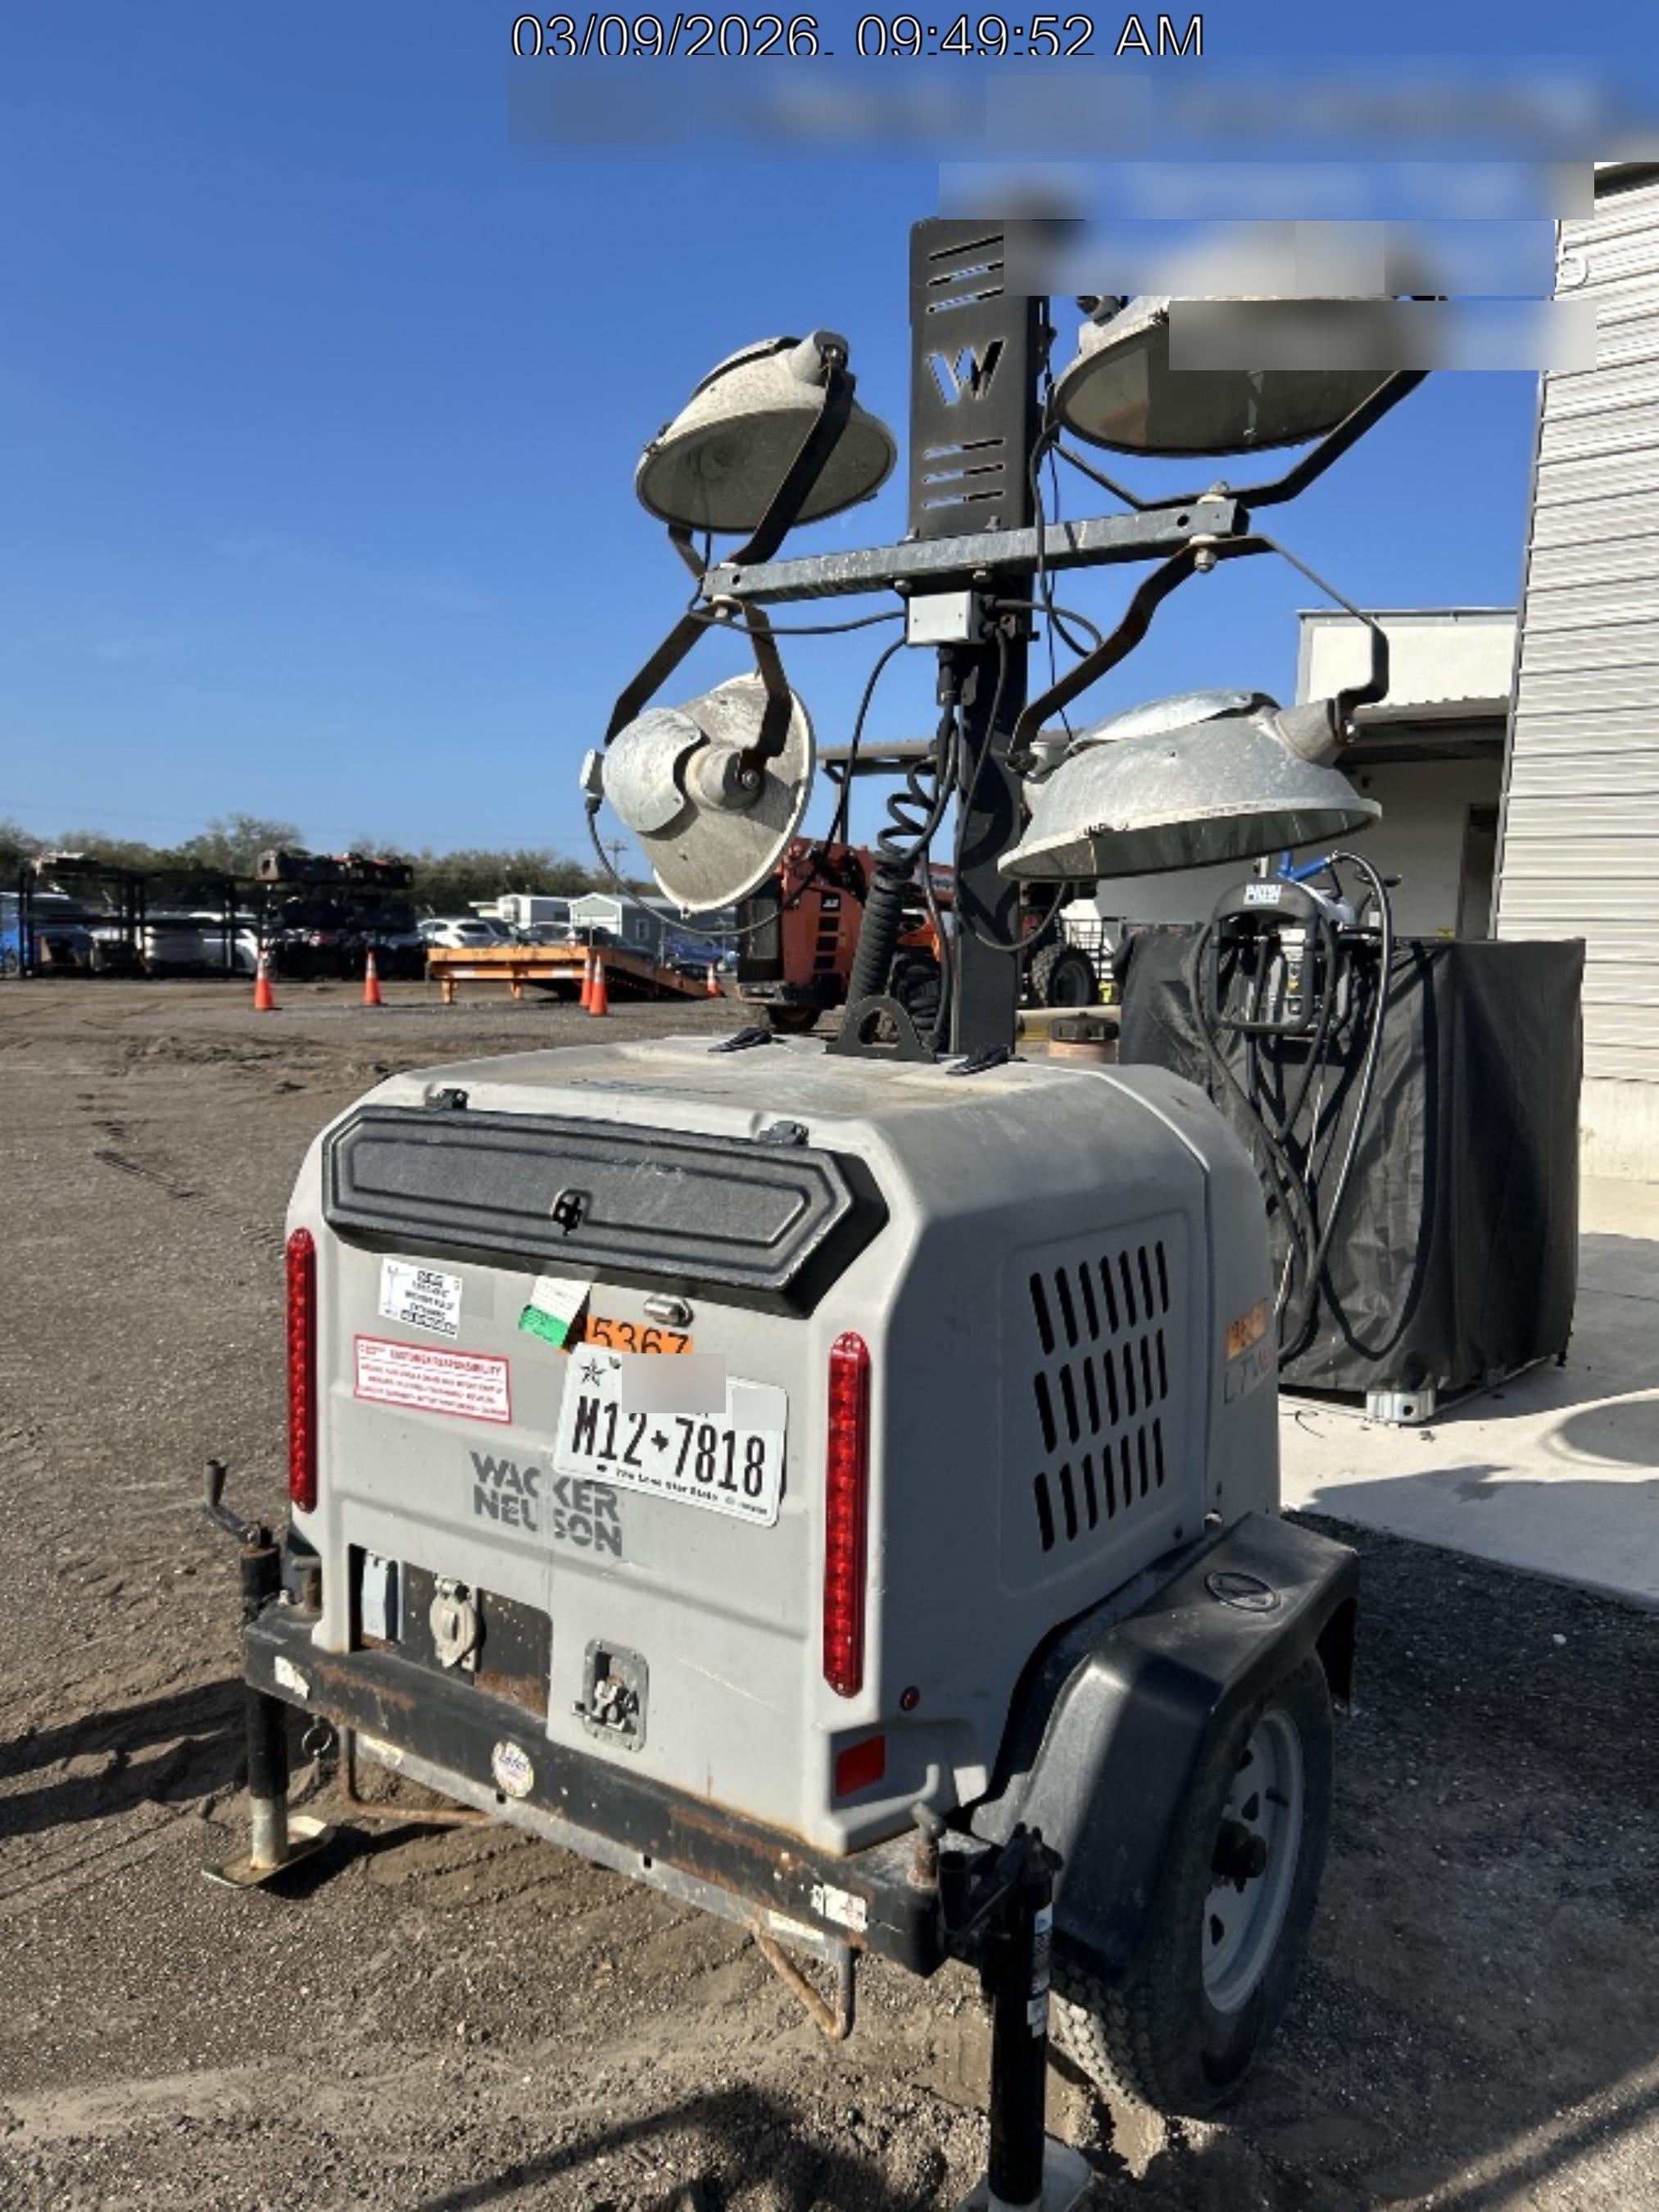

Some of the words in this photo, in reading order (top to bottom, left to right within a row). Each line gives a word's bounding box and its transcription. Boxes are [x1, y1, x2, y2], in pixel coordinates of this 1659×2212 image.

[592, 1317, 689, 1353] 5367
[469, 1449, 620, 1523] WACKER
[675, 1416, 765, 1498] 7818
